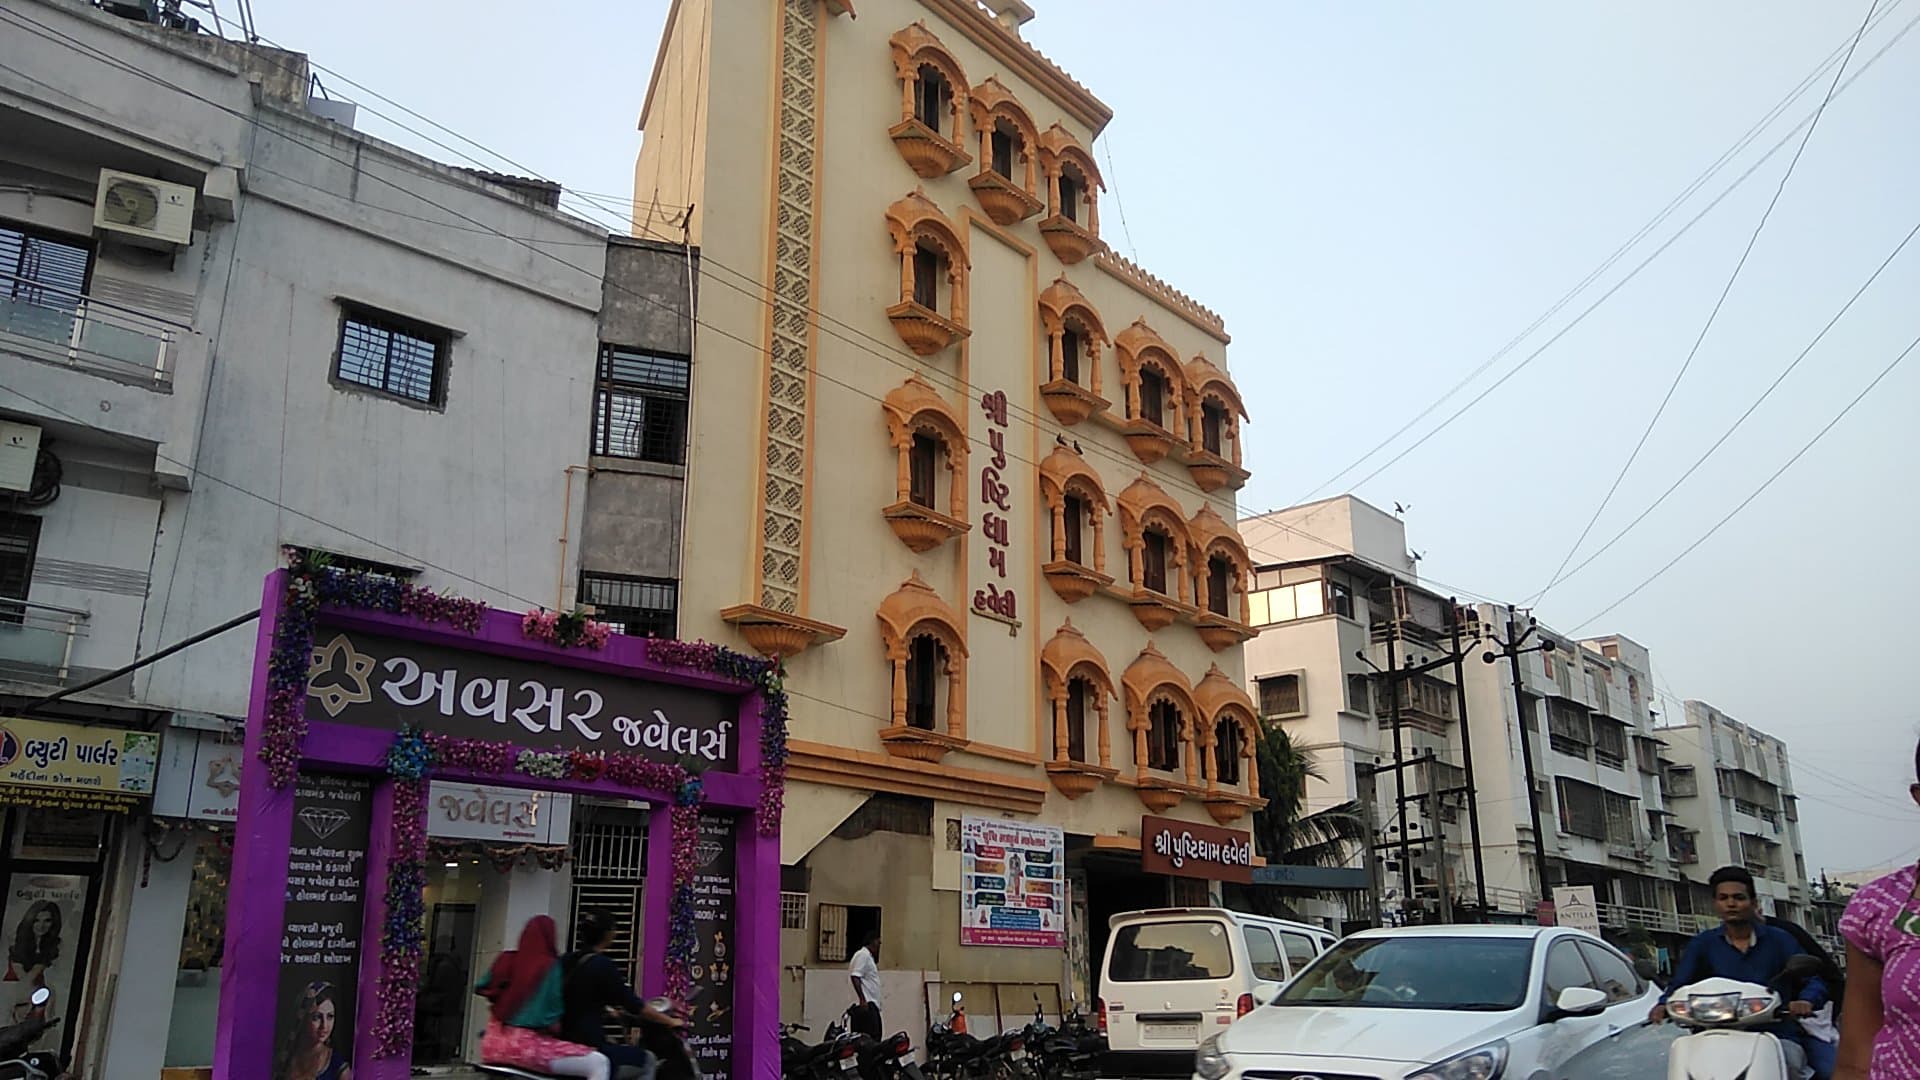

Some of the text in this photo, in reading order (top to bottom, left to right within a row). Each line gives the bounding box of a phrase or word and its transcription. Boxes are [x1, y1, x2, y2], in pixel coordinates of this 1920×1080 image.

[981, 390, 1008, 428] શ્રી
[974, 582, 1017, 620] હવેલી
[381, 656, 602, 741] અવસર
[25, 736, 118, 768] બ્યુટી પાર્લર
[1155, 829, 1171, 855] શ્રી
[1222, 837, 1252, 866] હવેલી
